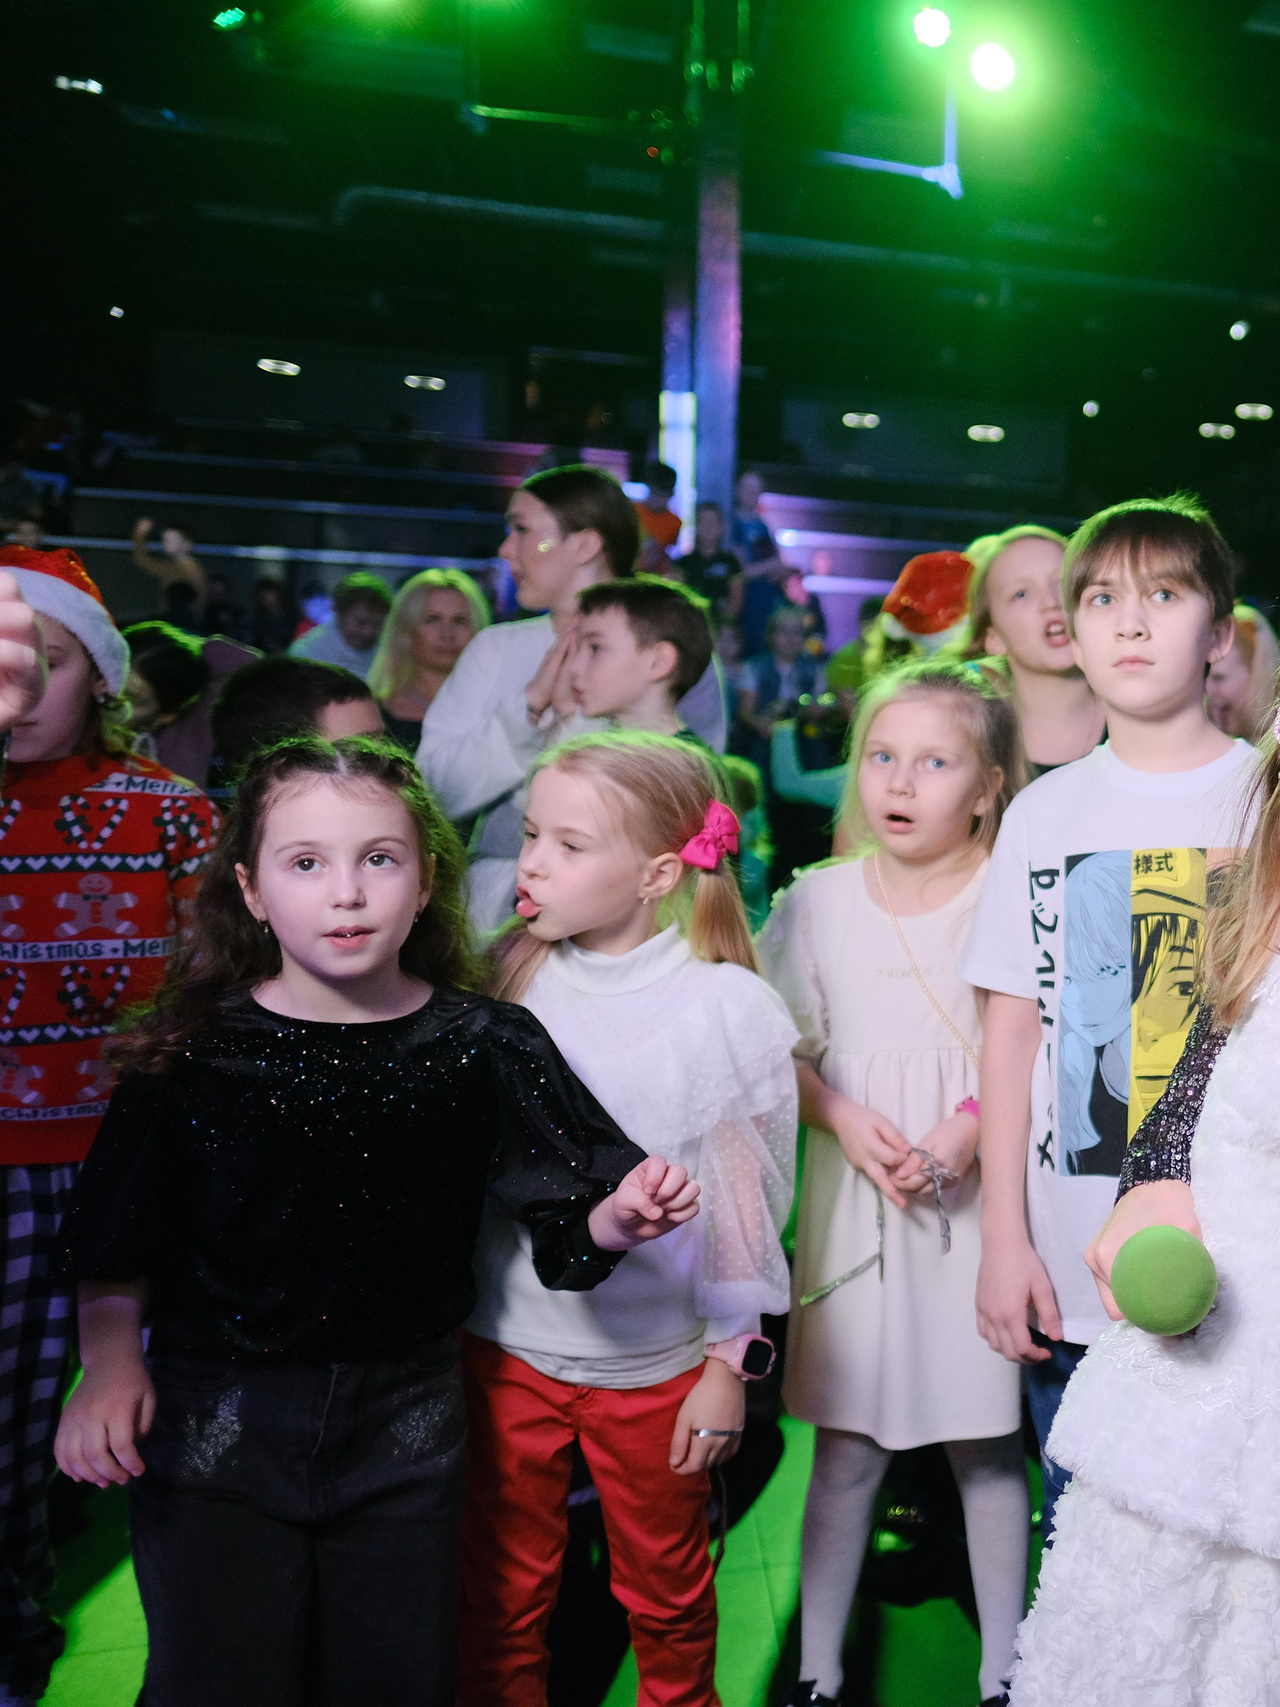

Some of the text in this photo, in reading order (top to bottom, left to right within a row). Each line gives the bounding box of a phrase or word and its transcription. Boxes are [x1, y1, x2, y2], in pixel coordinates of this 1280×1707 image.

[1134, 851, 1174, 876] 様式
[0, 941, 104, 960] hristmas
[1, 1102, 107, 1119] Christma
